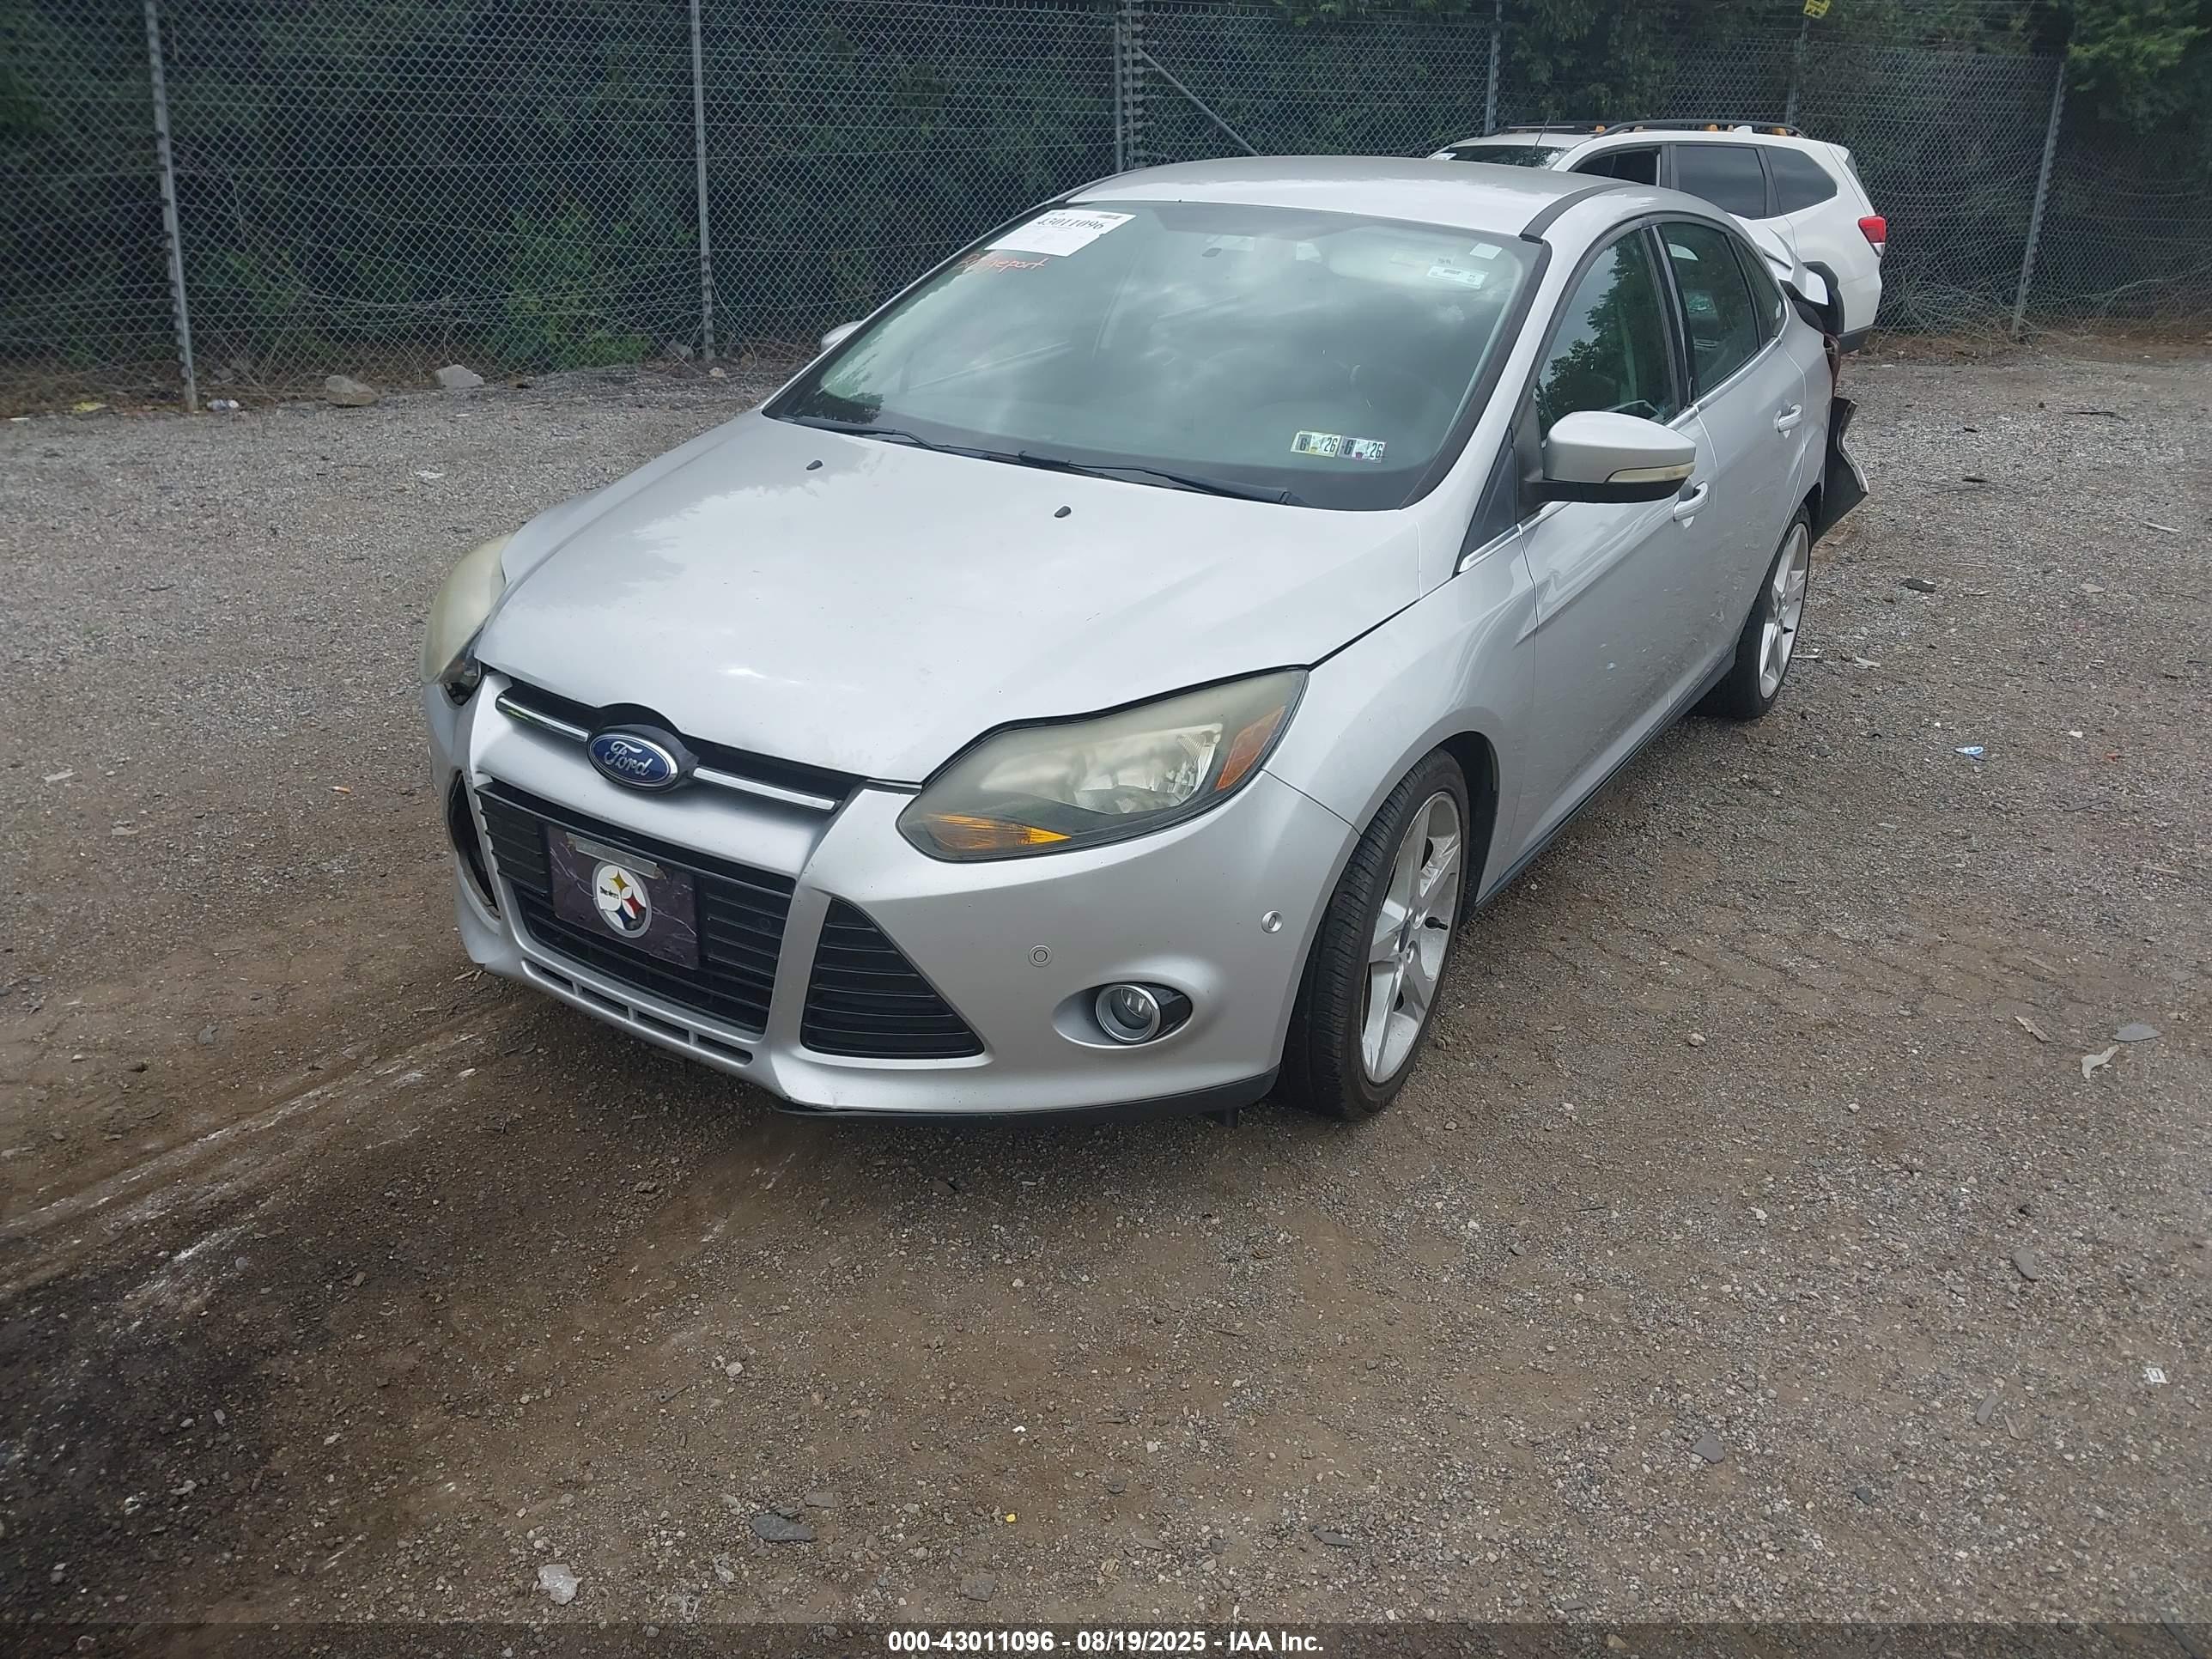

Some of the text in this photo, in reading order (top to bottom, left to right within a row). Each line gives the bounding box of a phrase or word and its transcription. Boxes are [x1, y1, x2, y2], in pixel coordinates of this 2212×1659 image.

[1037, 217, 1104, 230] 43011096
[1299, 437, 1338, 453] 6 26
[1369, 442, 1383, 459] 26
[604, 741, 653, 775] Ford
